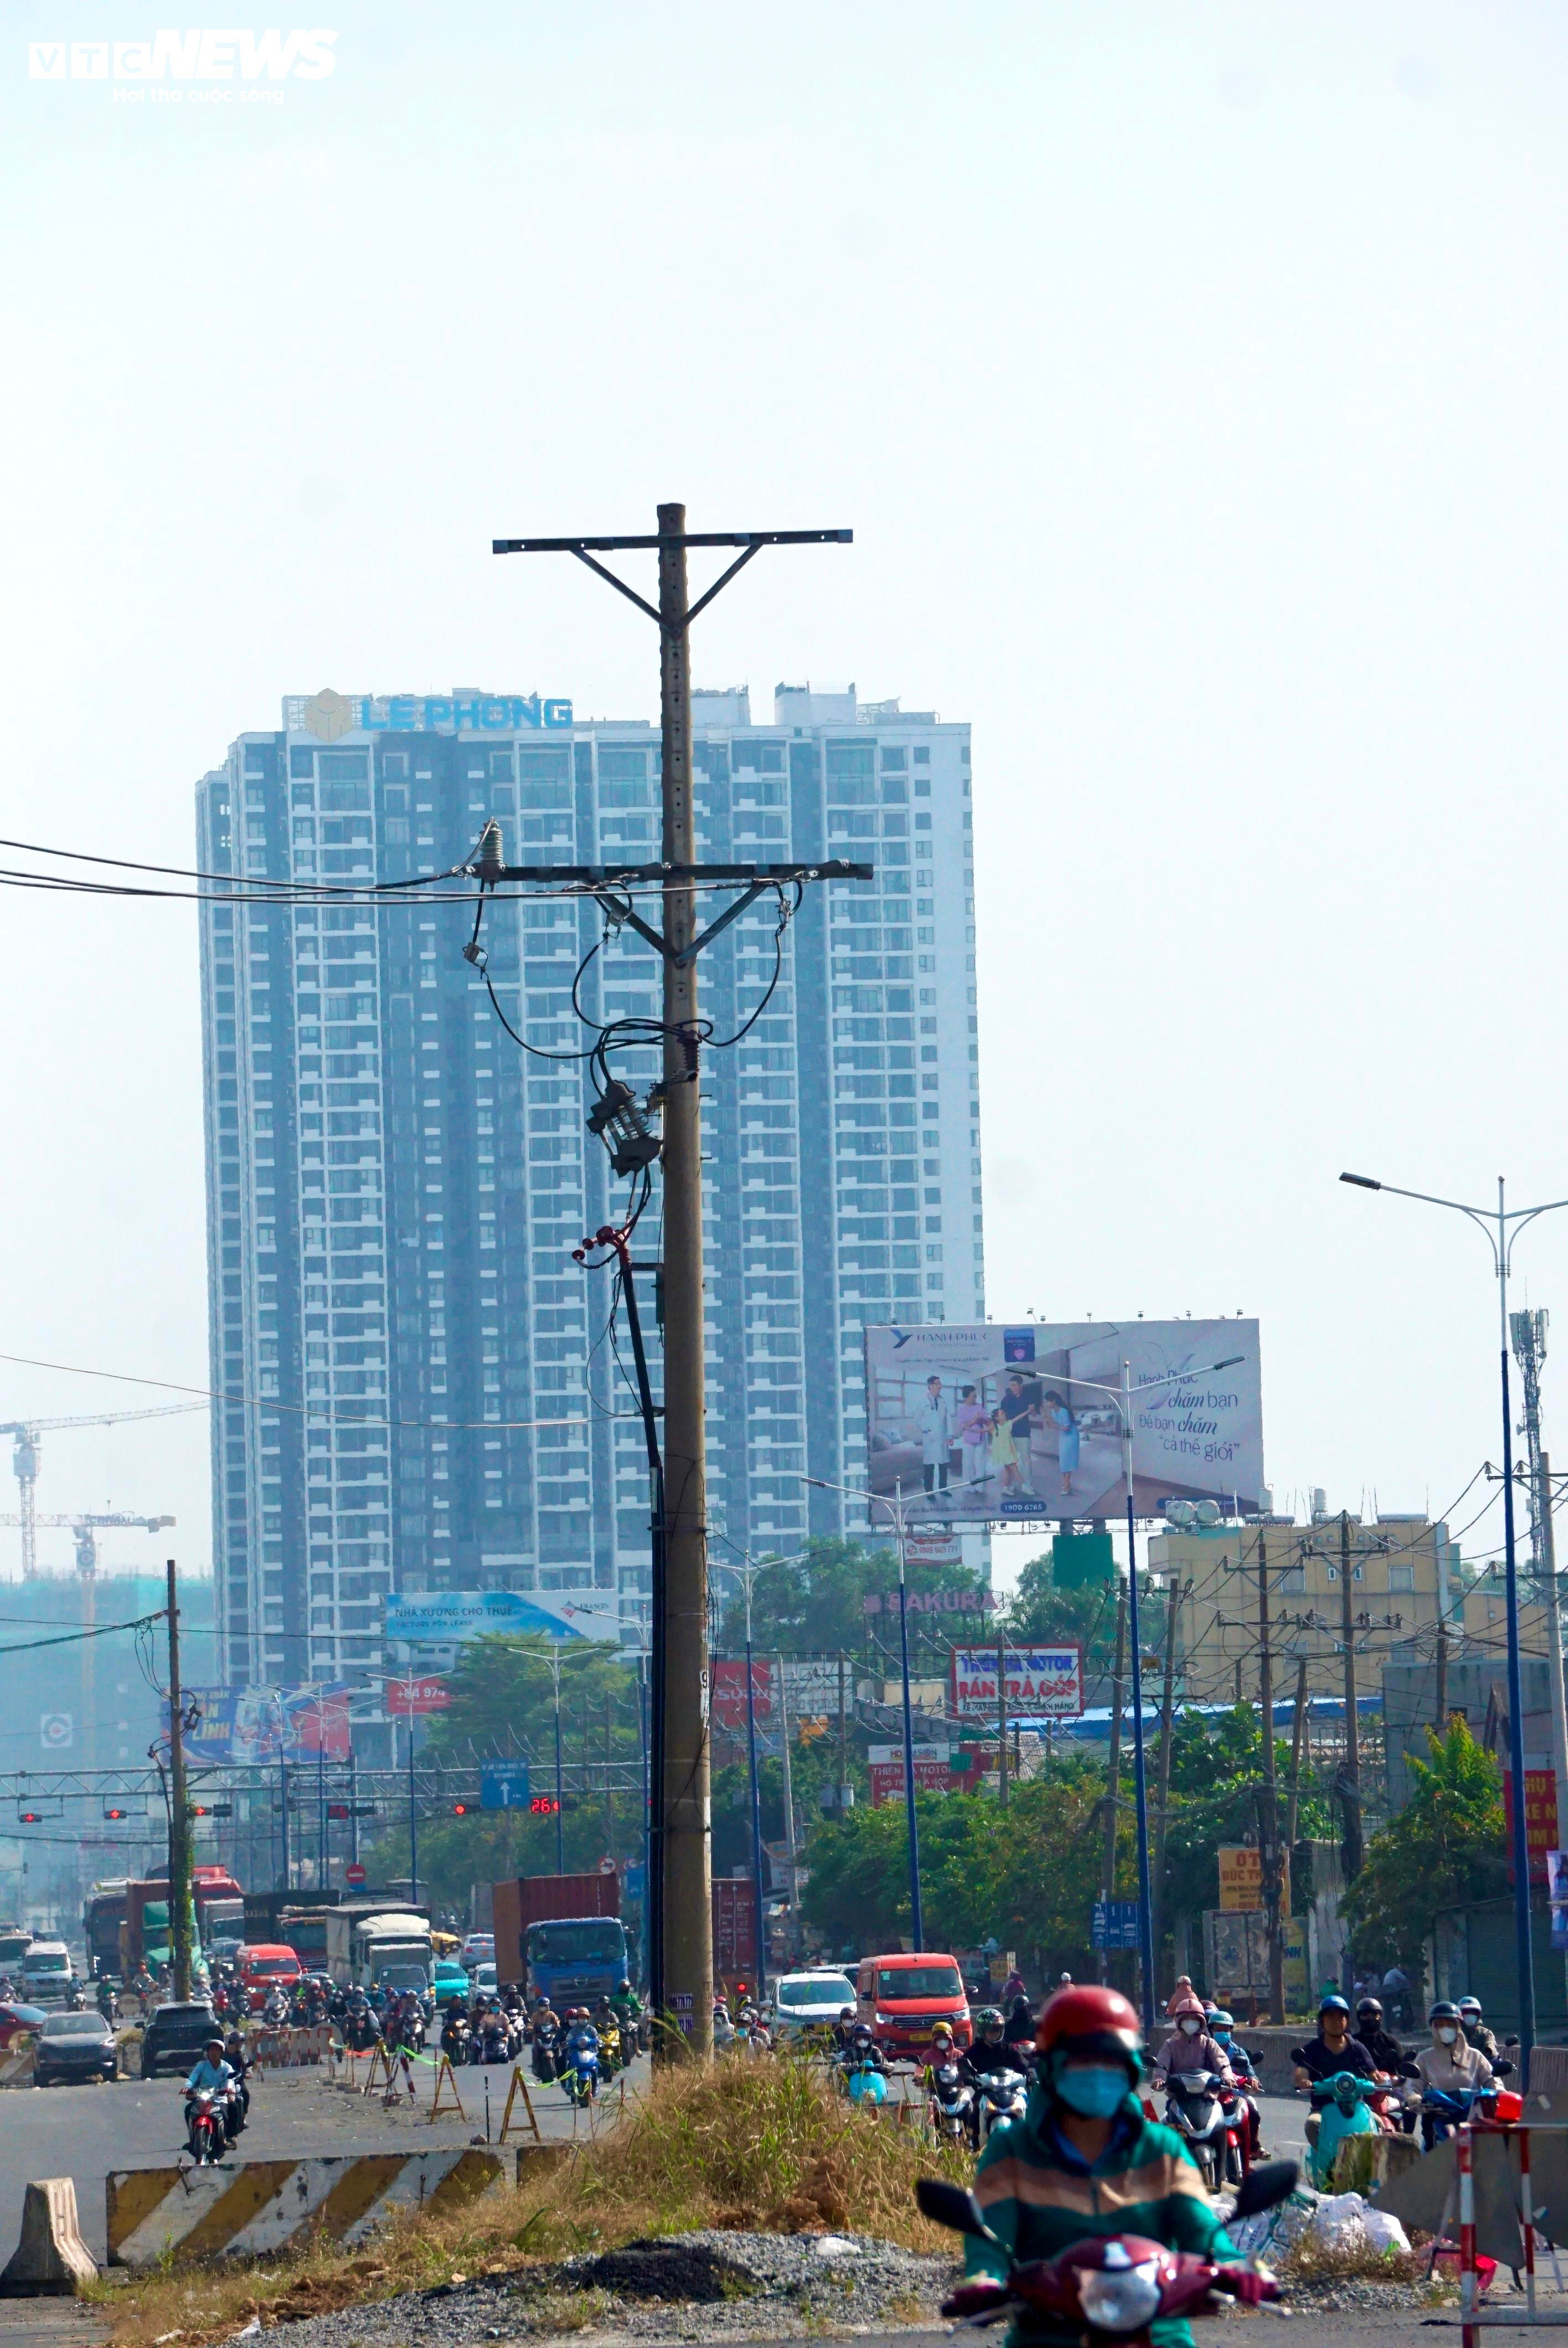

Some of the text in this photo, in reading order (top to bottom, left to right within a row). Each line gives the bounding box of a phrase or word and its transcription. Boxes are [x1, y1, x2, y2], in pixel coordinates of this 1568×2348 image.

[425, 698, 573, 730] PHONG
[1168, 1387, 1239, 1410] chăm bạn
[1155, 1416, 1175, 1432] bạn
[1178, 1412, 1218, 1435] chăm
[1180, 1436, 1200, 1455] thế
[461, 1607, 483, 1616] CHO
[888, 1591, 999, 1612] SAKURA
[958, 1676, 995, 1698] BÁN
[532, 1798, 550, 1814] 26
